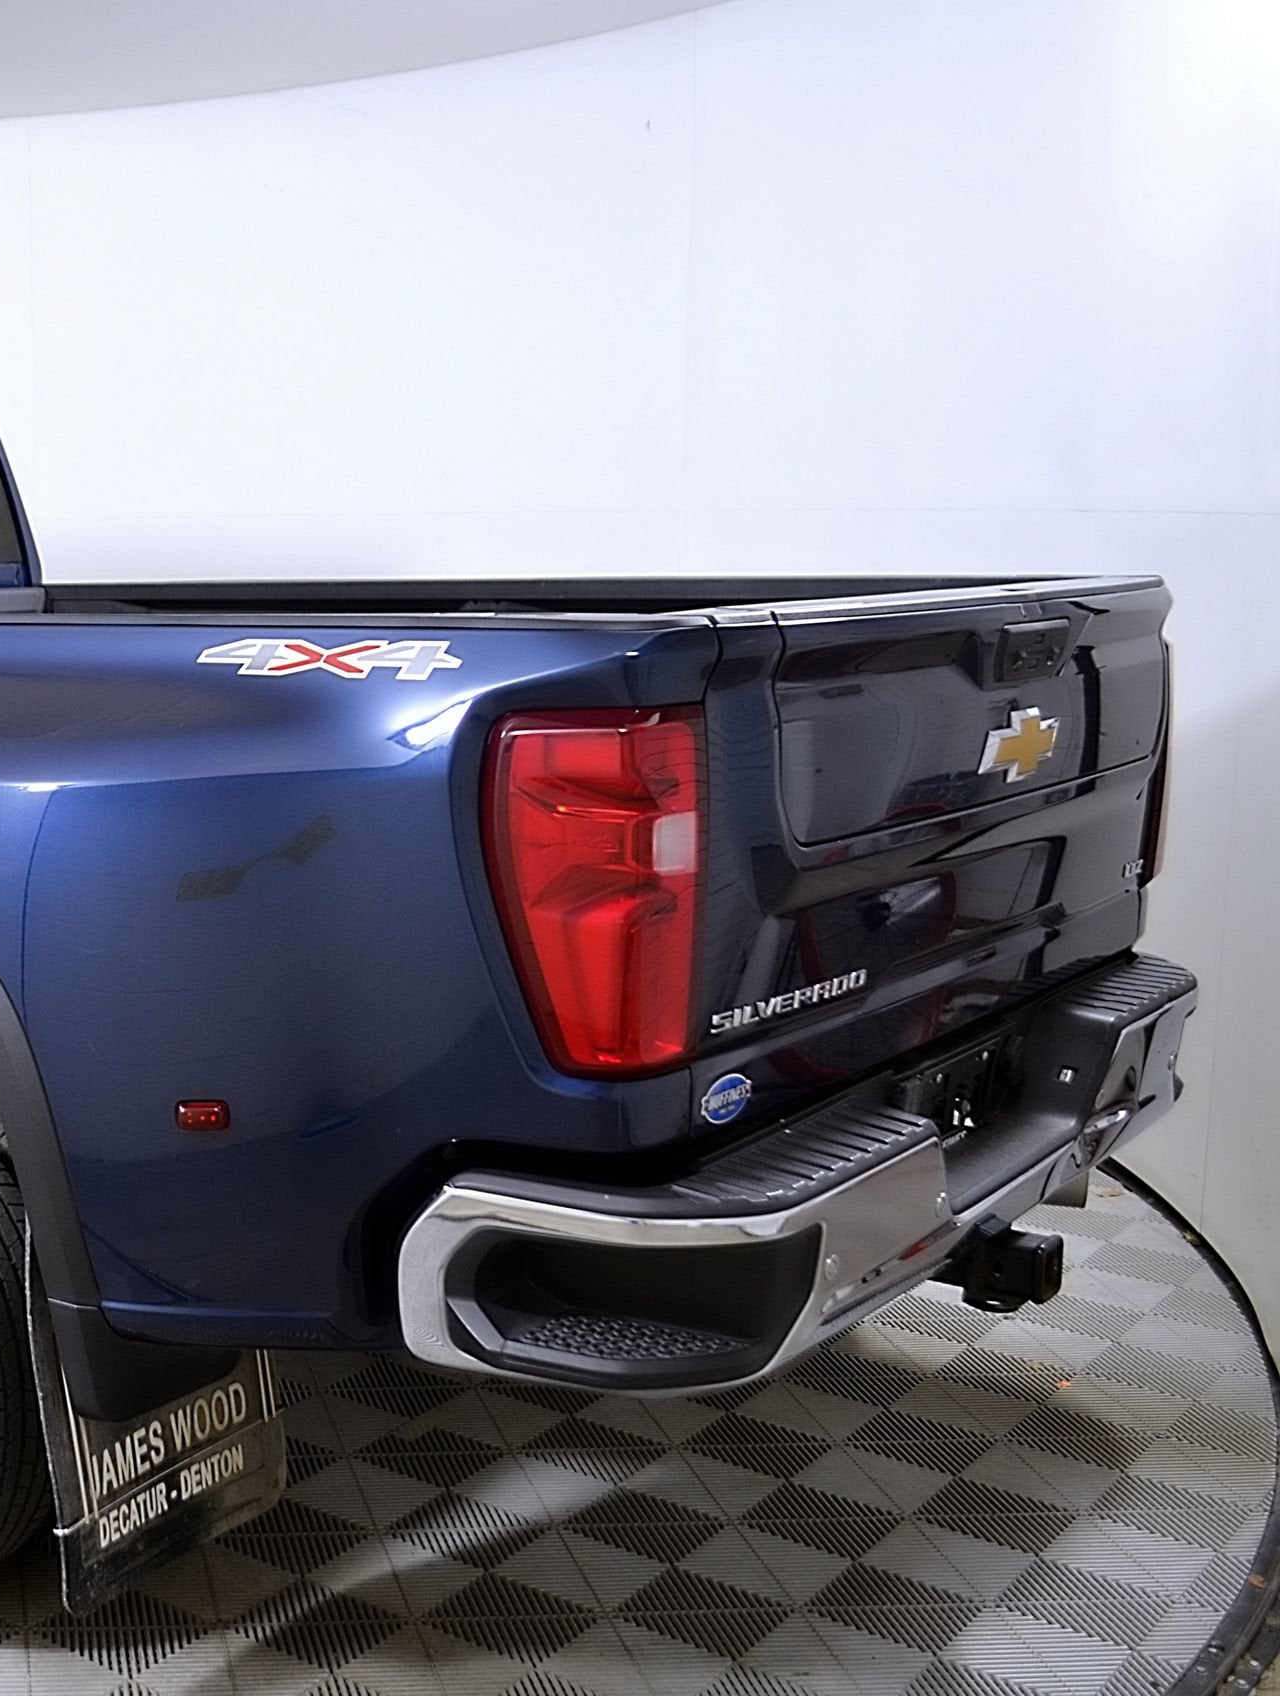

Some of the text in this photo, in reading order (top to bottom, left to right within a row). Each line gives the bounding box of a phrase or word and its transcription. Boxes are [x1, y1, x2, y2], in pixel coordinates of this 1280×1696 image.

[710, 968, 868, 1034] SILVERADO
[91, 1382, 247, 1500] JAMES WOOD
[99, 1481, 169, 1548] DECATUR
[179, 1443, 244, 1500] DENTON
